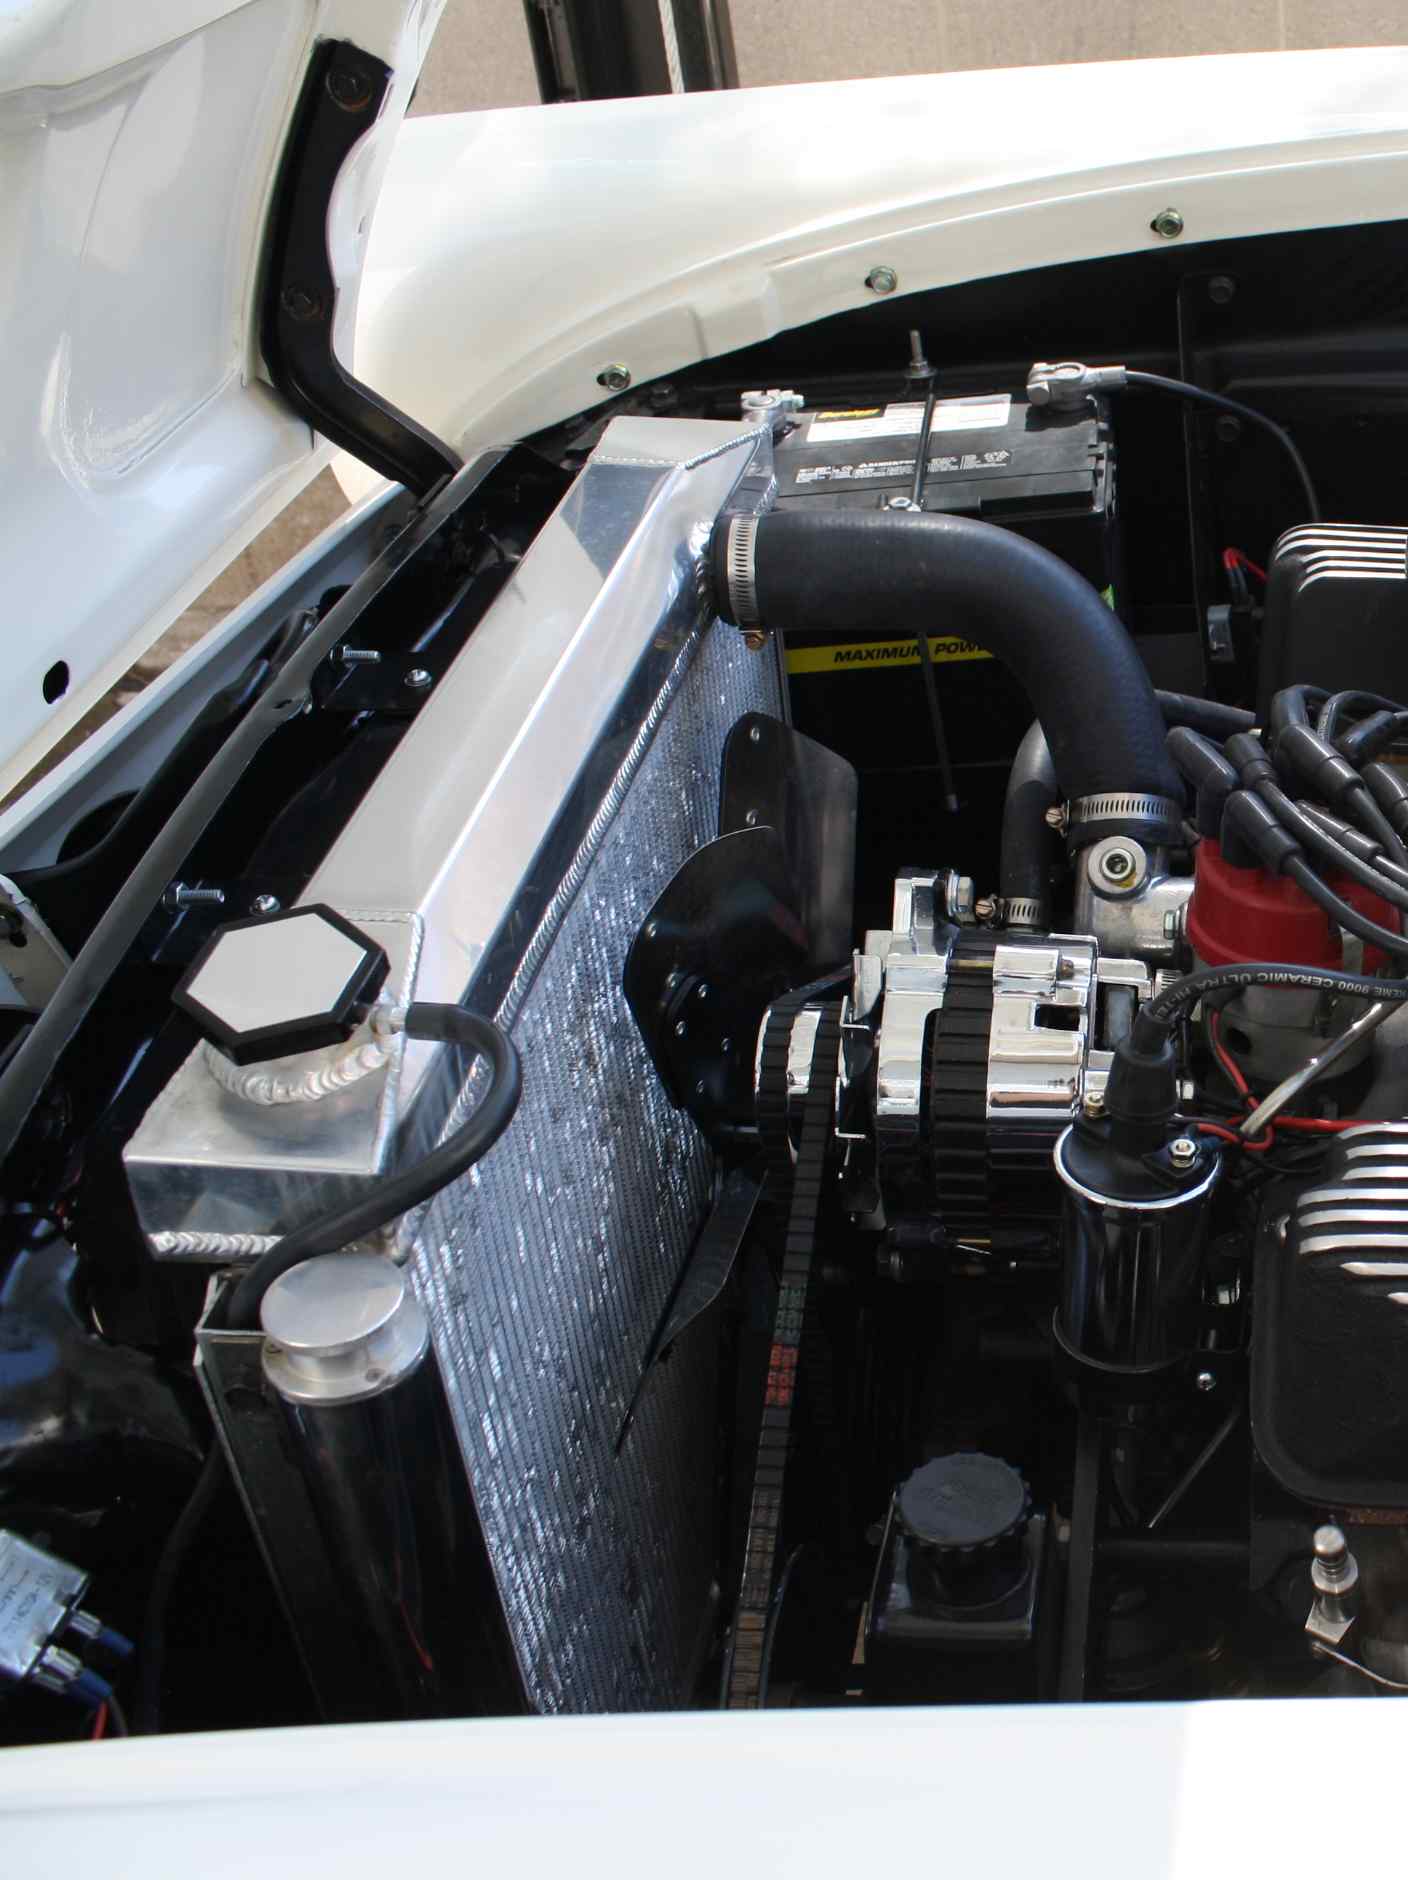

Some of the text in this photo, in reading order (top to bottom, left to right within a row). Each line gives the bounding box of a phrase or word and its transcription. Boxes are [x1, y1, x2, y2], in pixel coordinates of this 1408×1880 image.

[934, 641, 984, 656] POW
[1195, 972, 1251, 991] ULTRA
[1256, 971, 1335, 989] CERAMIC
[1337, 980, 1370, 995] 9000
